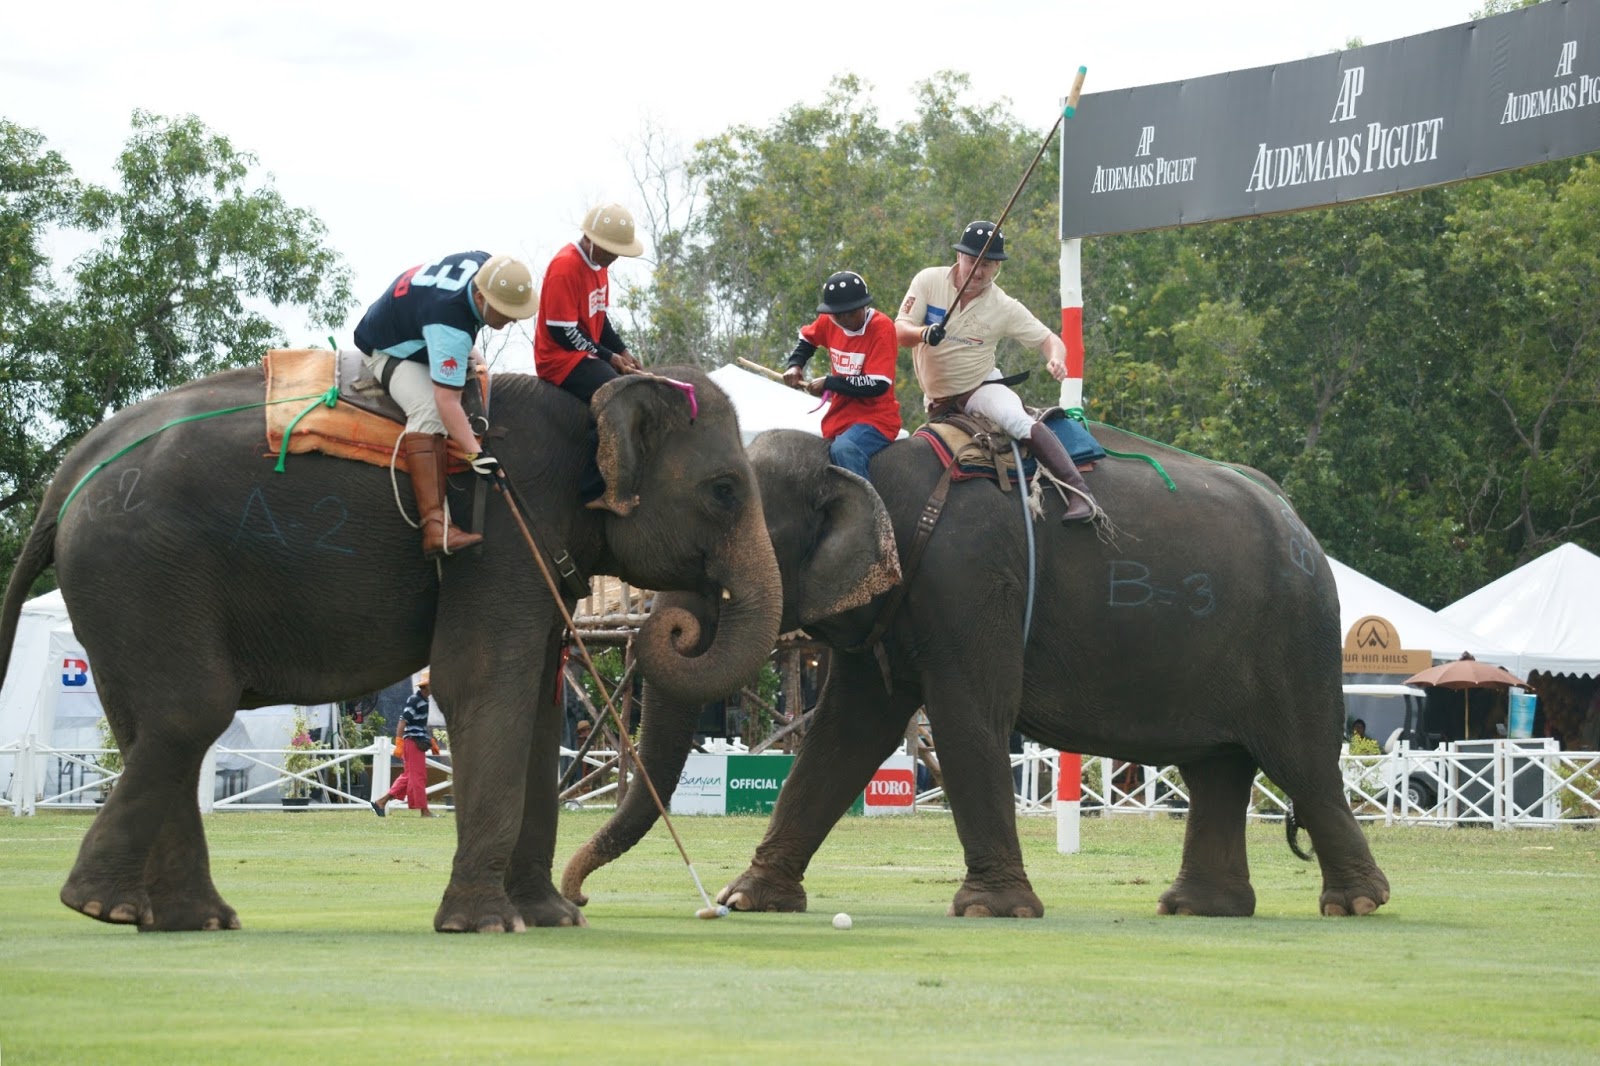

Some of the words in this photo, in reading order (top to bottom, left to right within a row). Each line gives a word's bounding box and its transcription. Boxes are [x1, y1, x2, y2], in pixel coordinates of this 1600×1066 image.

[1330, 66, 1364, 123] AP
[1500, 82, 1577, 124] AUDEMARS
[1578, 74, 1600, 107] PIG
[1246, 133, 1361, 192] AUDEMARS
[1363, 117, 1443, 173] PIGUET
[1091, 163, 1154, 193] AUDEMARS
[1155, 157, 1197, 186] PIGUET
[1344, 654, 1358, 663] UA
[1362, 654, 1379, 663] HIN
[1382, 655, 1408, 664] HILLS
[679, 771, 721, 791] Banyan
[730, 778, 778, 790] OFFICIAL
